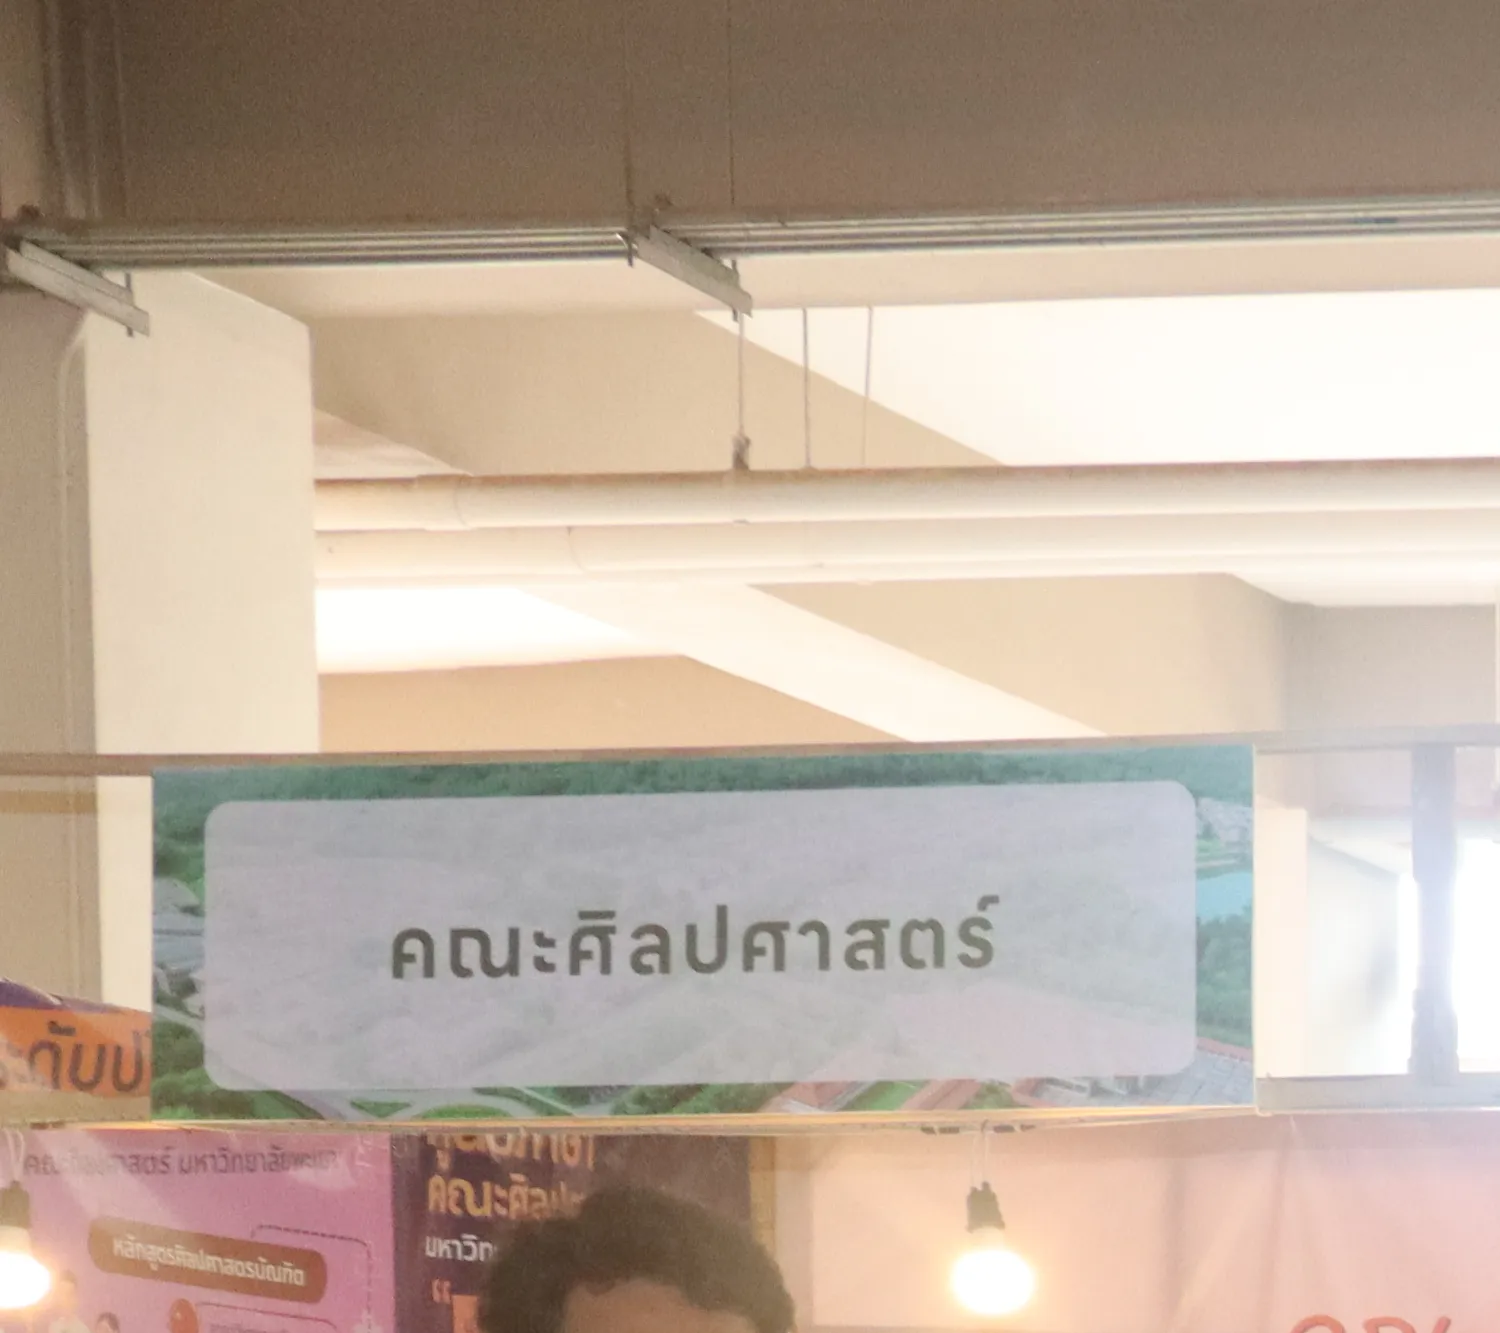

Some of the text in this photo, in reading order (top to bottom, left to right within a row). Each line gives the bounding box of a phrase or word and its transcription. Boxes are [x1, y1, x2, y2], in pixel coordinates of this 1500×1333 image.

[391, 895, 1000, 980] คณะศิลปศาสตร์
